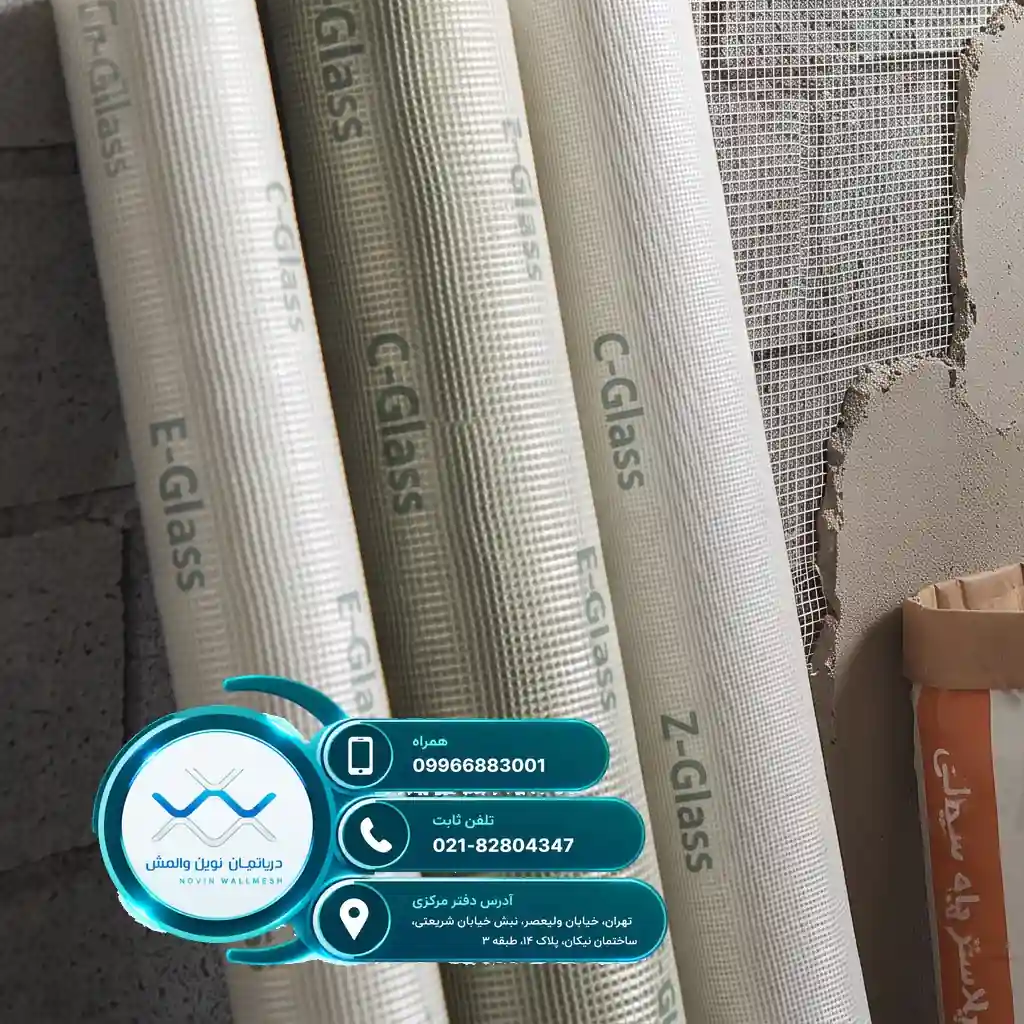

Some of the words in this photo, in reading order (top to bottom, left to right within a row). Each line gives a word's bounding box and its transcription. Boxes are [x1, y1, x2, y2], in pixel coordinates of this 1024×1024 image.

[265, 182, 305, 332] C-Glass
[367, 332, 426, 515] C-Glass
[594, 333, 644, 491] C-Glass
[149, 417, 205, 592] E-Glass
[576, 546, 617, 711] E-Glass
[660, 711, 713, 873] Z-Glass
